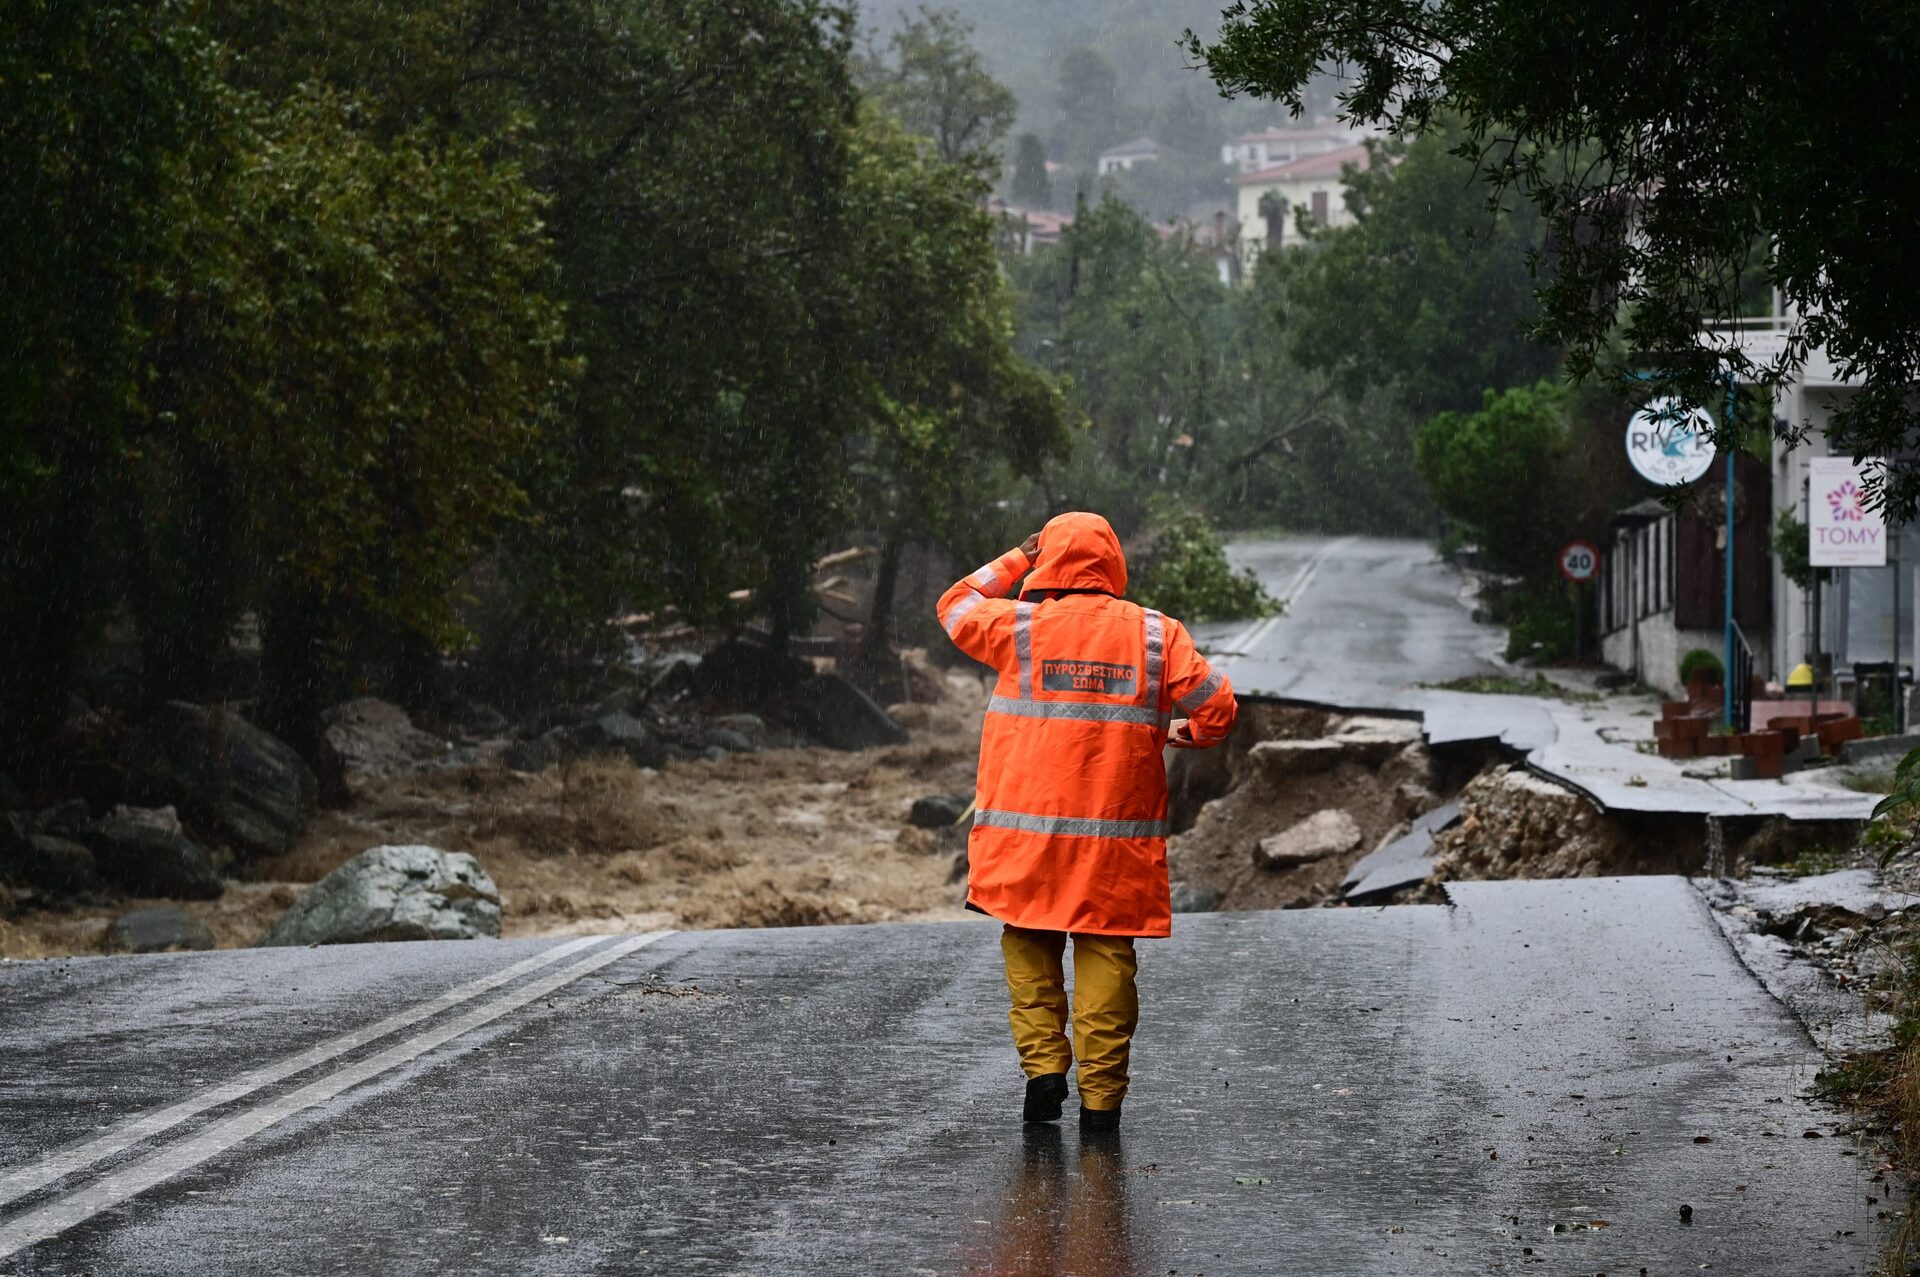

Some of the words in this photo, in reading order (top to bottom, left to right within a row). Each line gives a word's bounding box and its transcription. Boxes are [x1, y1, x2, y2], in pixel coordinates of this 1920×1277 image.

[1816, 526, 1880, 545] TOMY
[1567, 553, 1591, 570] 40
[1045, 663, 1134, 680] ΠΥΡΟΣΒΕΣΤΙΚΟ
[1072, 677, 1105, 690] ΣΩΜΑ
